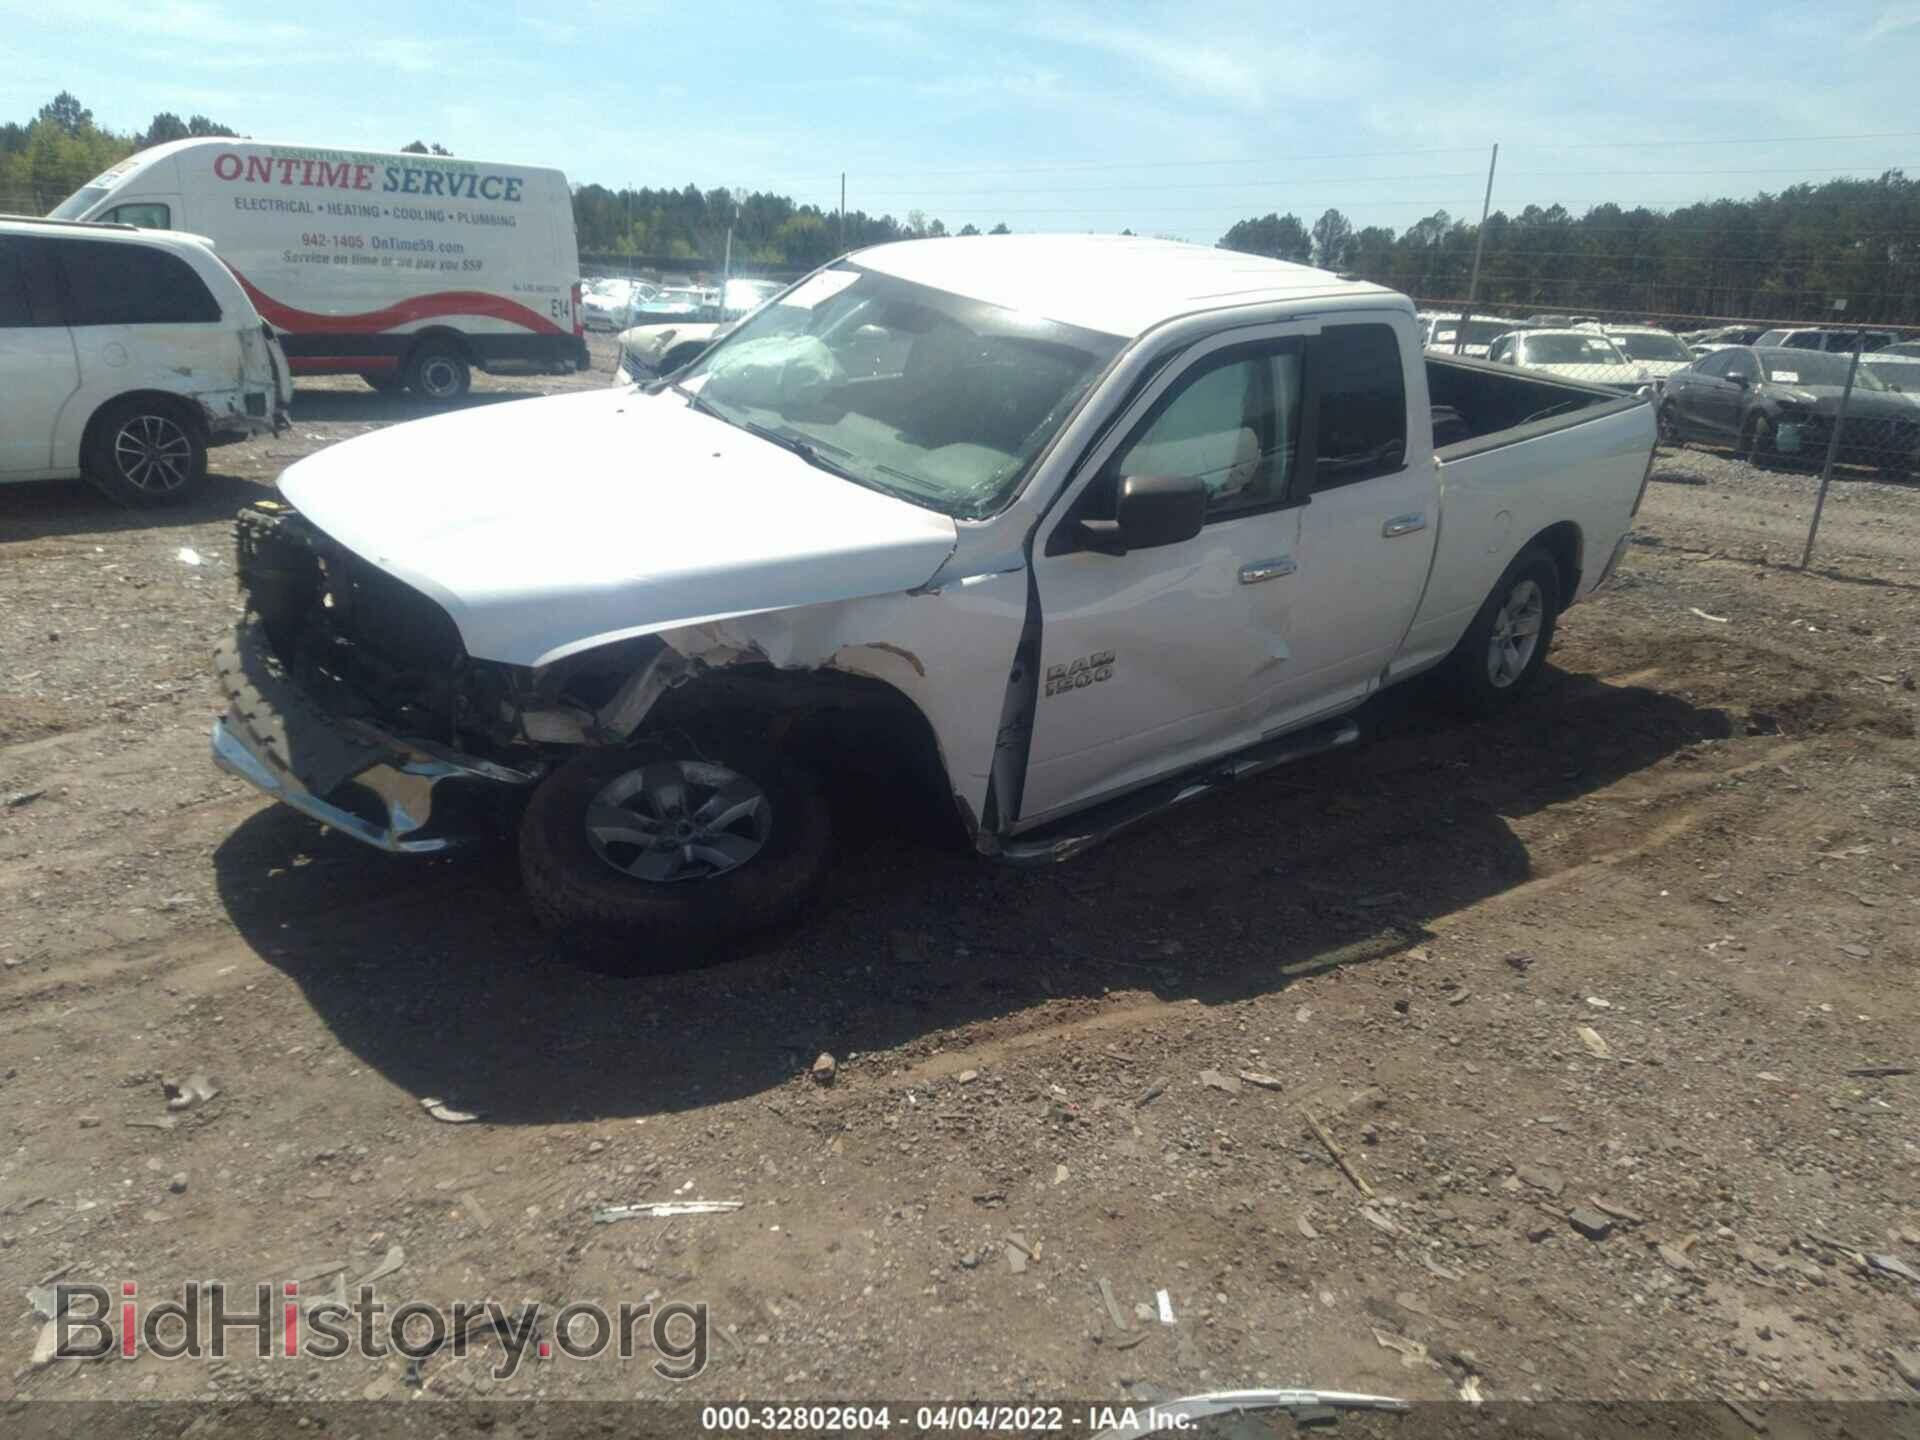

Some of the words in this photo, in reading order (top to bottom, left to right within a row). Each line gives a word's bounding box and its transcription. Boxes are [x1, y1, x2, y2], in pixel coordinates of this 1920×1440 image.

[214, 153, 374, 190] ONTIME
[383, 167, 523, 202] SERVICE
[234, 197, 313, 214] ELECTRICAL
[327, 202, 379, 218] HEATING
[393, 207, 444, 223] COOLING
[457, 211, 516, 227] PLUMBING
[301, 233, 364, 249] 942-1405
[371, 236, 464, 254] OnTime59.com
[283, 250, 329, 265] Service
[334, 255, 348, 265] on
[352, 254, 378, 266] time
[416, 258, 435, 270] pay
[439, 260, 458, 271] you
[551, 298, 568, 318] E14
[1046, 649, 1116, 681] RAM
